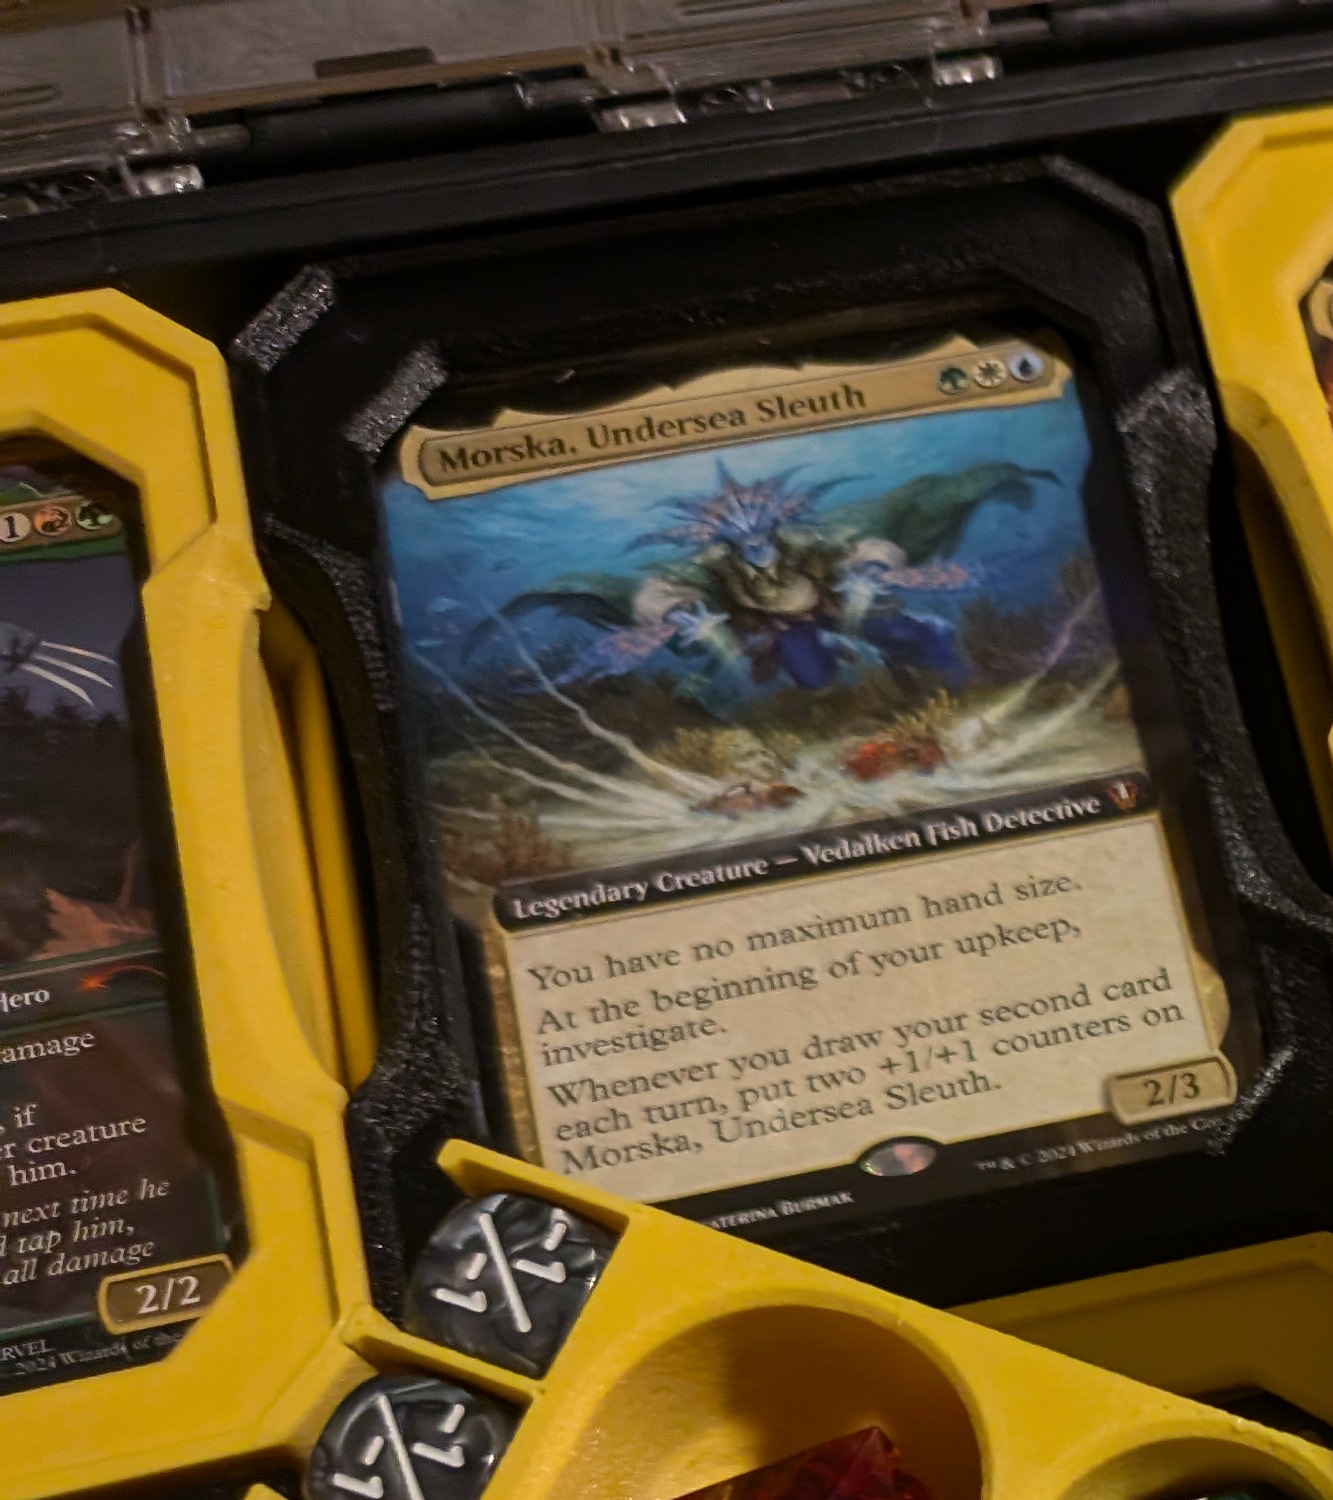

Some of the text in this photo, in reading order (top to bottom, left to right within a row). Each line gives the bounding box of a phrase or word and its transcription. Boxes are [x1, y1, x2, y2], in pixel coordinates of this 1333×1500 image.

[587, 408, 746, 449] Undersea
[756, 382, 866, 421] Sleuth
[513, 797, 1101, 918] Legendary Creature Vedalken Fish Detective
[528, 875, 1082, 990] You have no maximum hand size.
[539, 917, 1081, 1035] At the beginning of your upkeep,
[541, 1015, 727, 1067] investigate.
[548, 967, 1172, 1107] Whenever you draw your second card
[556, 1003, 1185, 1140] each turn, put two +1/+1 counters on
[1144, 1072, 1200, 1107] 2/3
[14, 1103, 37, 1128] if
[27, 1117, 146, 1154] creature
[561, 1070, 1002, 1175] Morska, Undersea Sleuth.
[7, 1160, 77, 1187] him.
[3, 1178, 170, 1228] next time he
[17, 1216, 135, 1254] tap him,
[3, 1241, 155, 1285] all damage
[136, 1275, 201, 1315] 2/2
